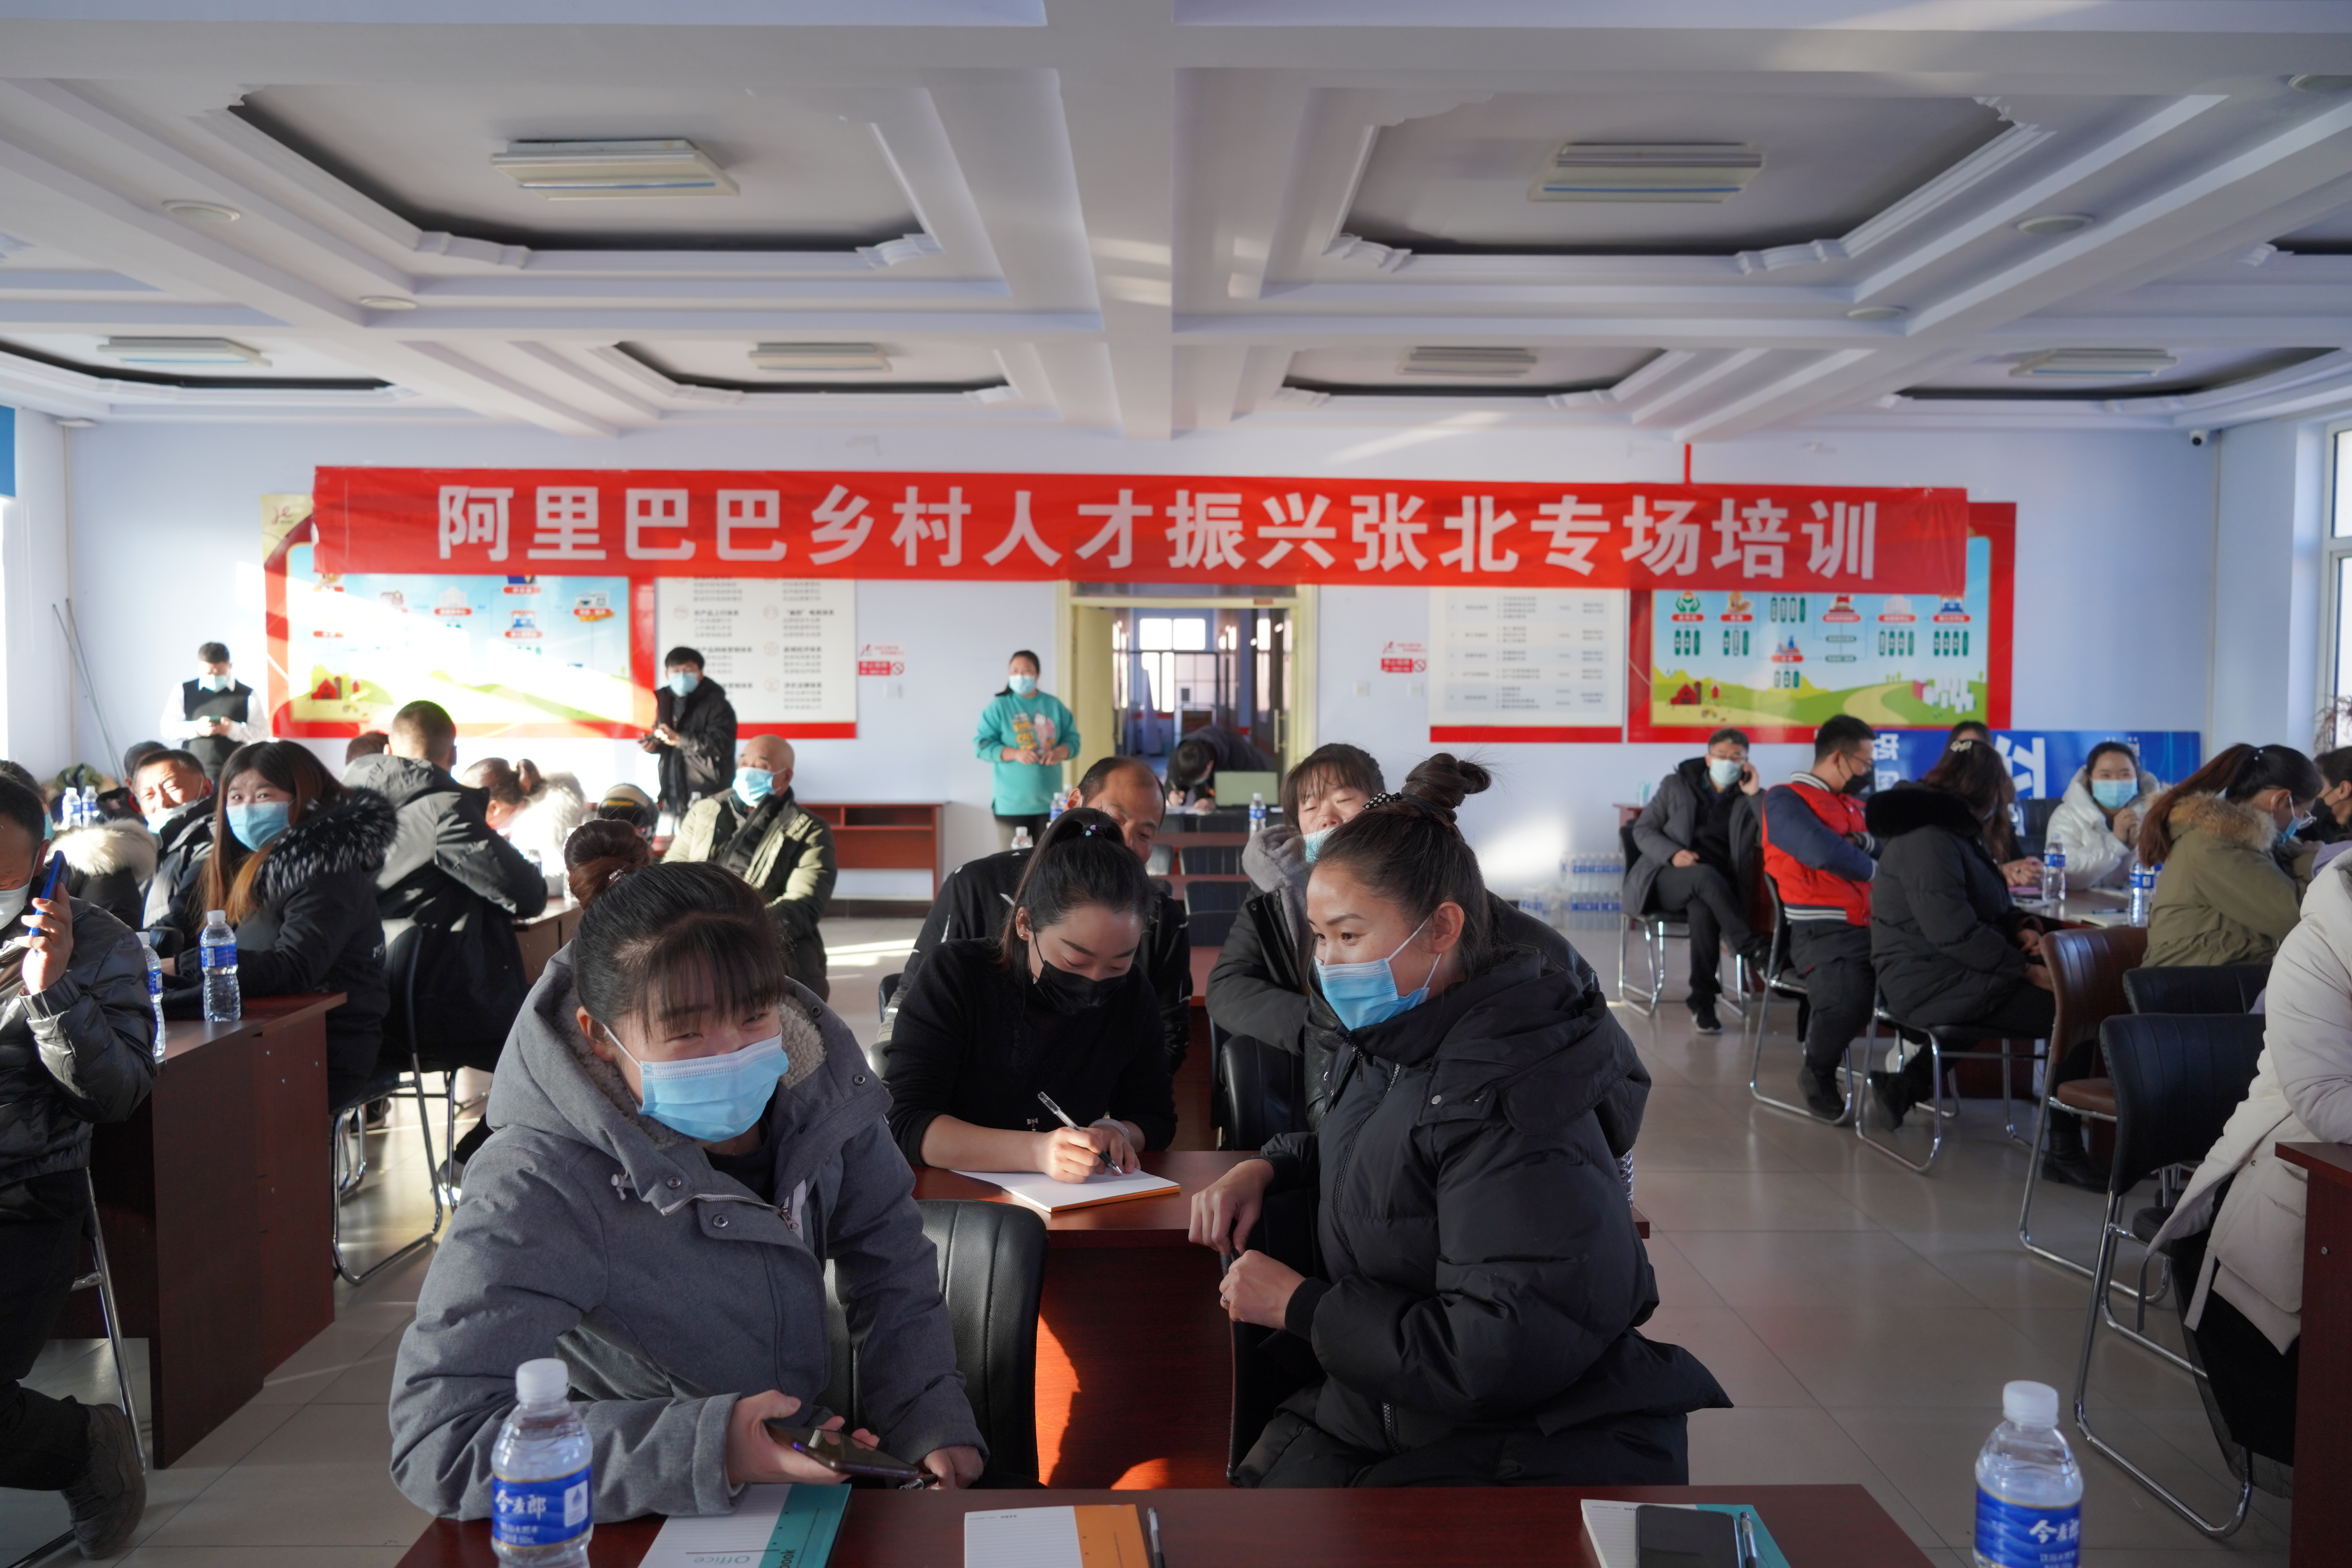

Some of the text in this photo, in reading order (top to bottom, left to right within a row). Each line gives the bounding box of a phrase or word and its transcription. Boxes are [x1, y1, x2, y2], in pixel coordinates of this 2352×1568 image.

[438, 485, 1876, 579] 阿里巴巴乡村人才振兴张北专场培训
[495, 1489, 547, 1521] 今麦郎
[2029, 1519, 2080, 1543] 今麦郎
[693, 1555, 750, 1564] Office
